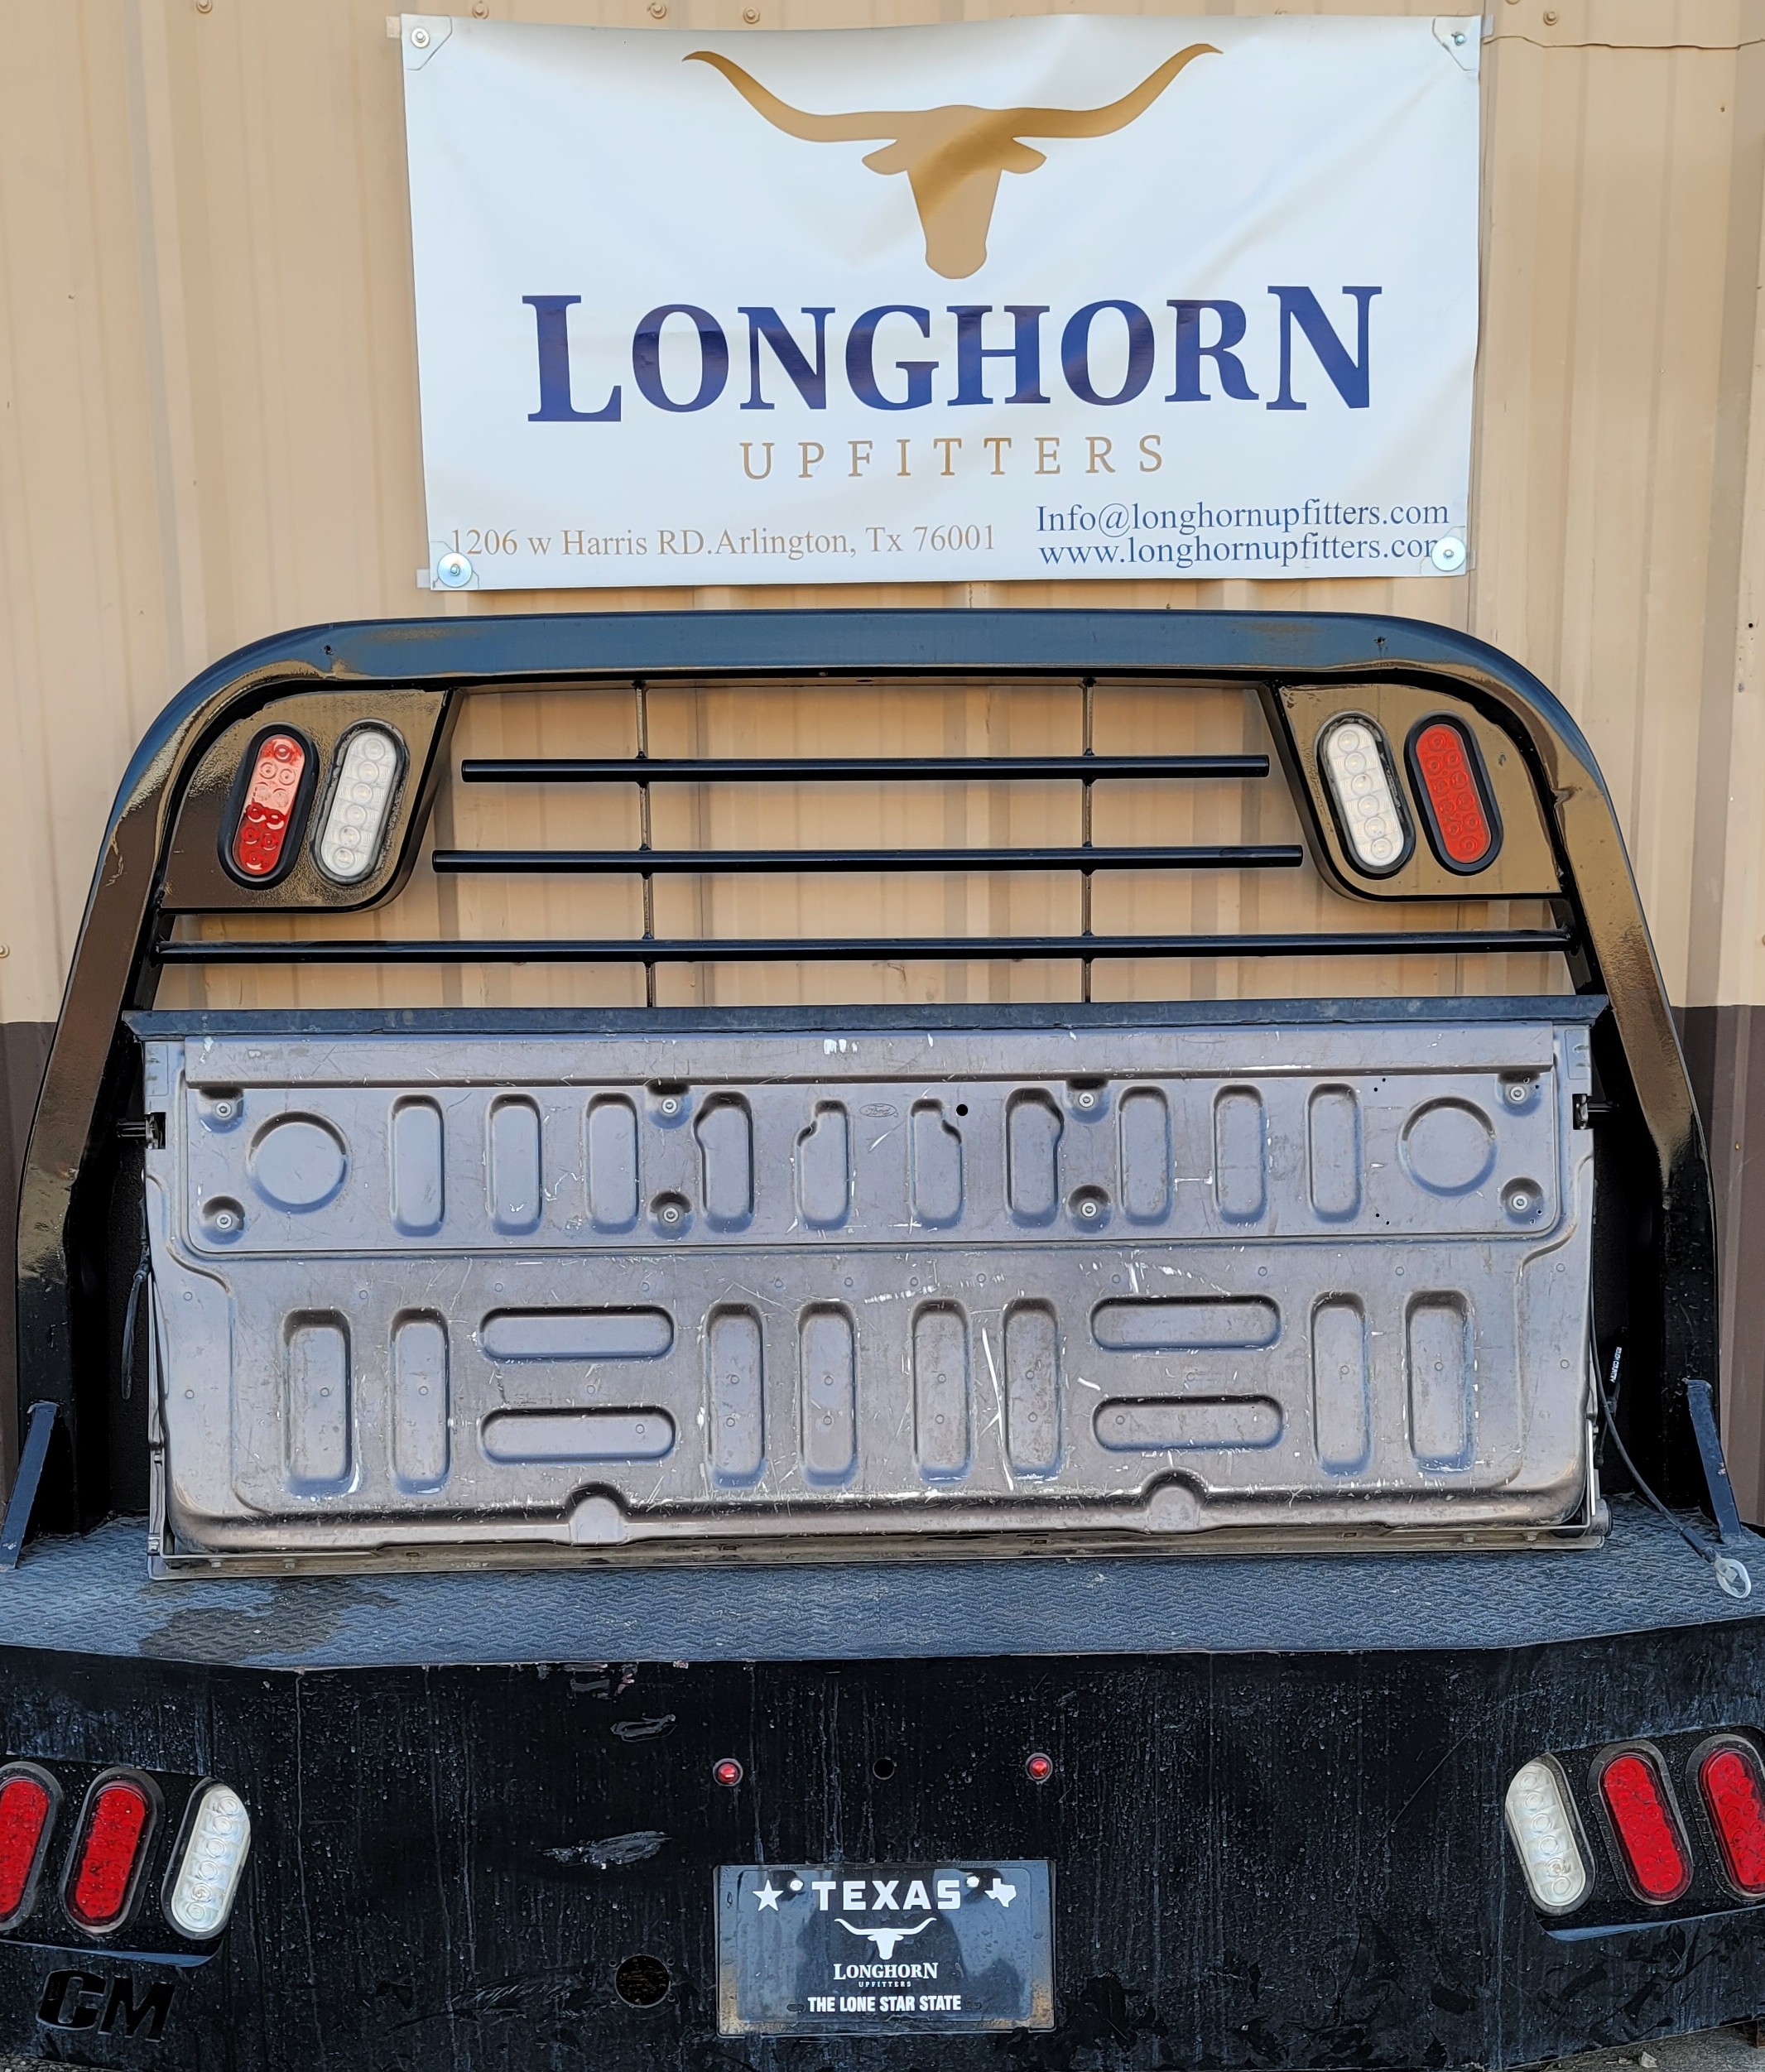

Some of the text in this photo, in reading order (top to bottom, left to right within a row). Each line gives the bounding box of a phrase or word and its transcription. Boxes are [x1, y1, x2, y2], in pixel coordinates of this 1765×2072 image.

[521, 286, 1383, 423] LONGHORN
[739, 434, 1163, 479] UPFITTERS
[1036, 498, 1450, 537] Info@longhornupfitters.com
[451, 529, 518, 556] 1206
[527, 536, 552, 555] w
[560, 528, 648, 556] Harris
[865, 526, 904, 554] Tx
[912, 524, 996, 552] 76001
[811, 1879, 962, 1911] TEXAS
[833, 1962, 939, 1981] LONGHORN
[36, 1969, 177, 2043] CM
[807, 1994, 962, 2013] THE LONE STAR STATE
